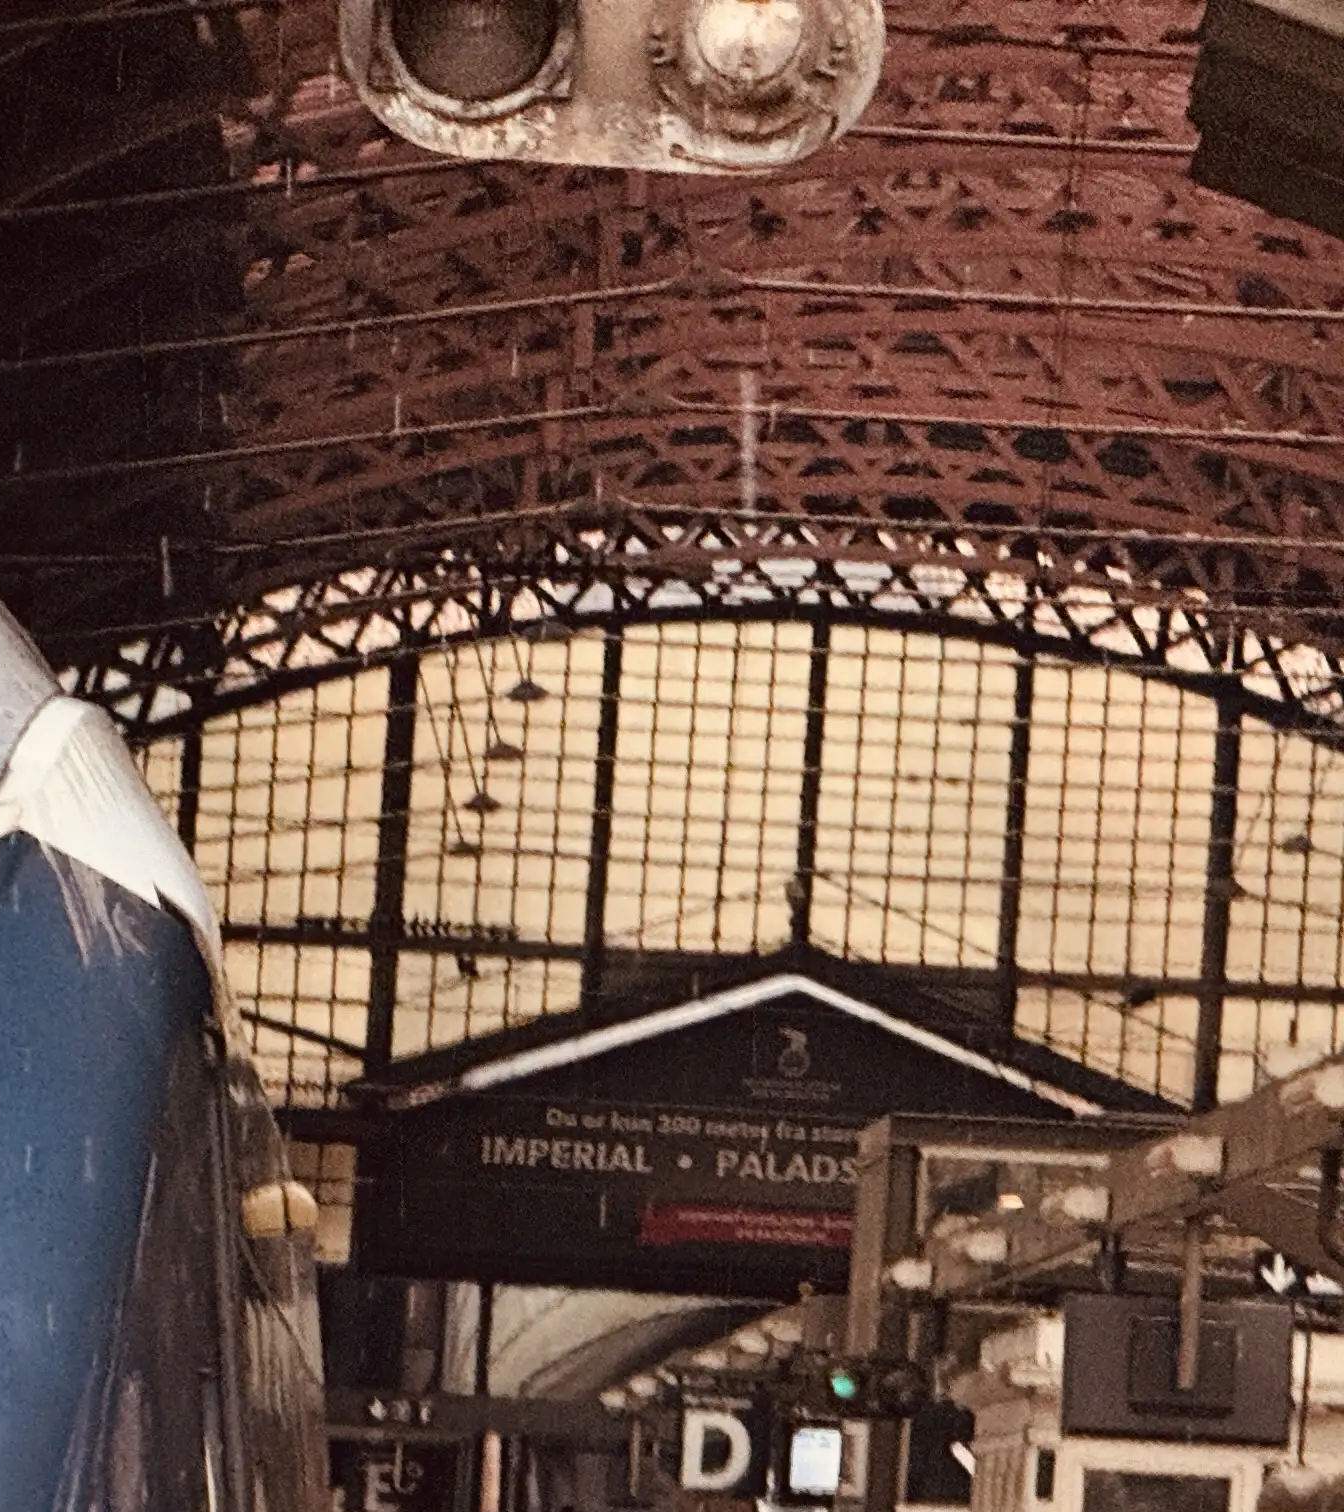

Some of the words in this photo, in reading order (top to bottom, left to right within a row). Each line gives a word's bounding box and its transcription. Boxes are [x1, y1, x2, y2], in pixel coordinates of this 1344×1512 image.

[480, 1135, 654, 1173] IMPERIAL
[715, 1149, 858, 1184] PALADS
[680, 1407, 750, 1490] D
